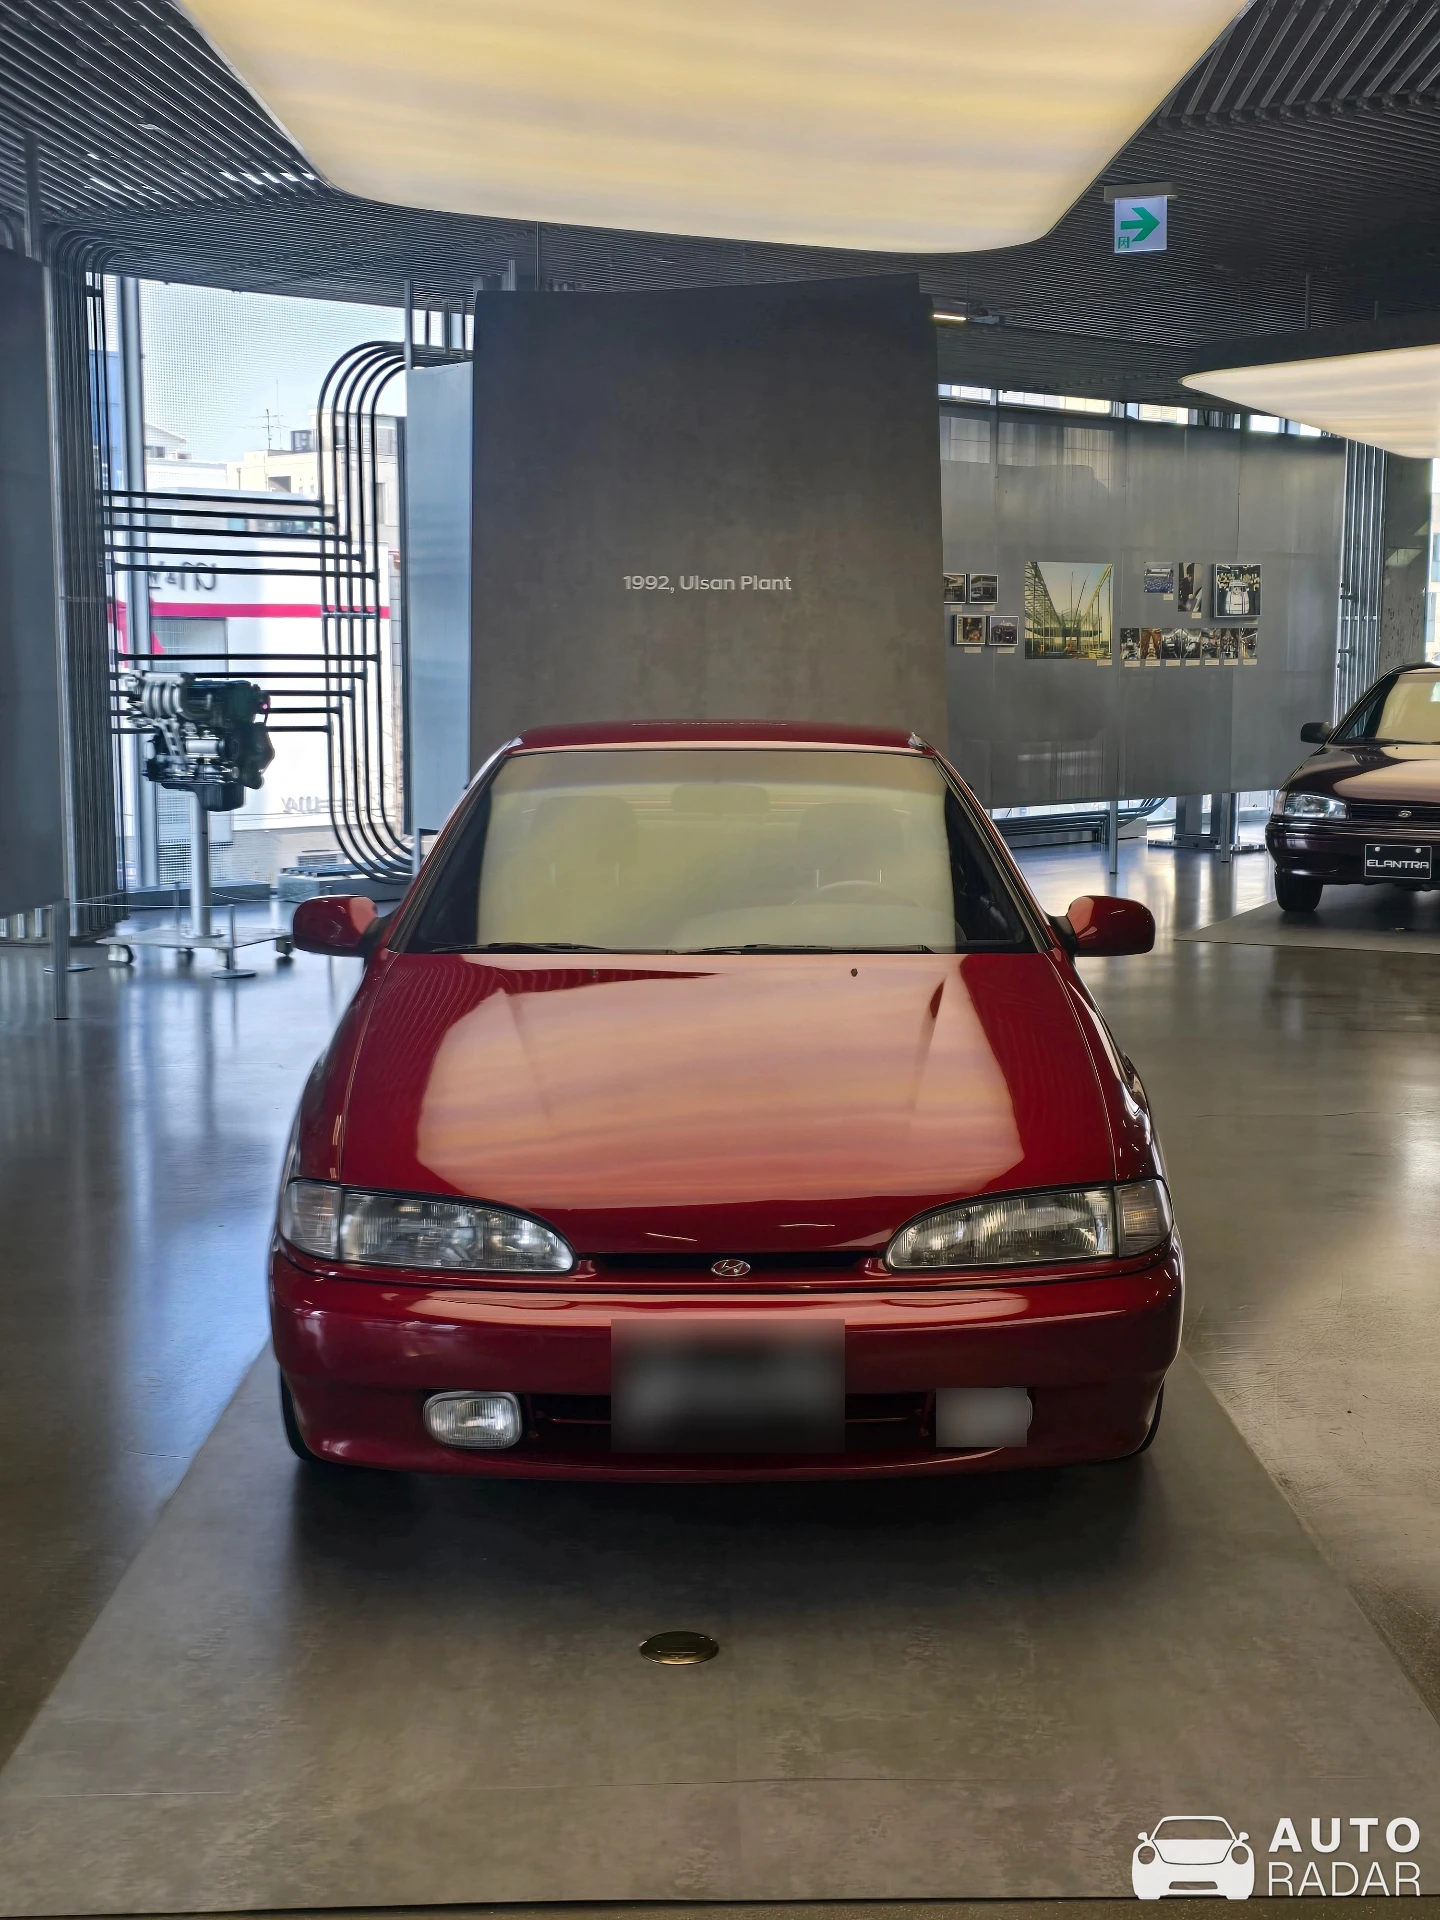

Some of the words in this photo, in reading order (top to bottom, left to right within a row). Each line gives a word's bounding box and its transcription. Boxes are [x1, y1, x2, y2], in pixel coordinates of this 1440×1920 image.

[623, 575, 675, 594] 1992,
[679, 575, 735, 591] Ulsan
[740, 575, 792, 591] Plant
[1366, 859, 1430, 869] ELANTRA
